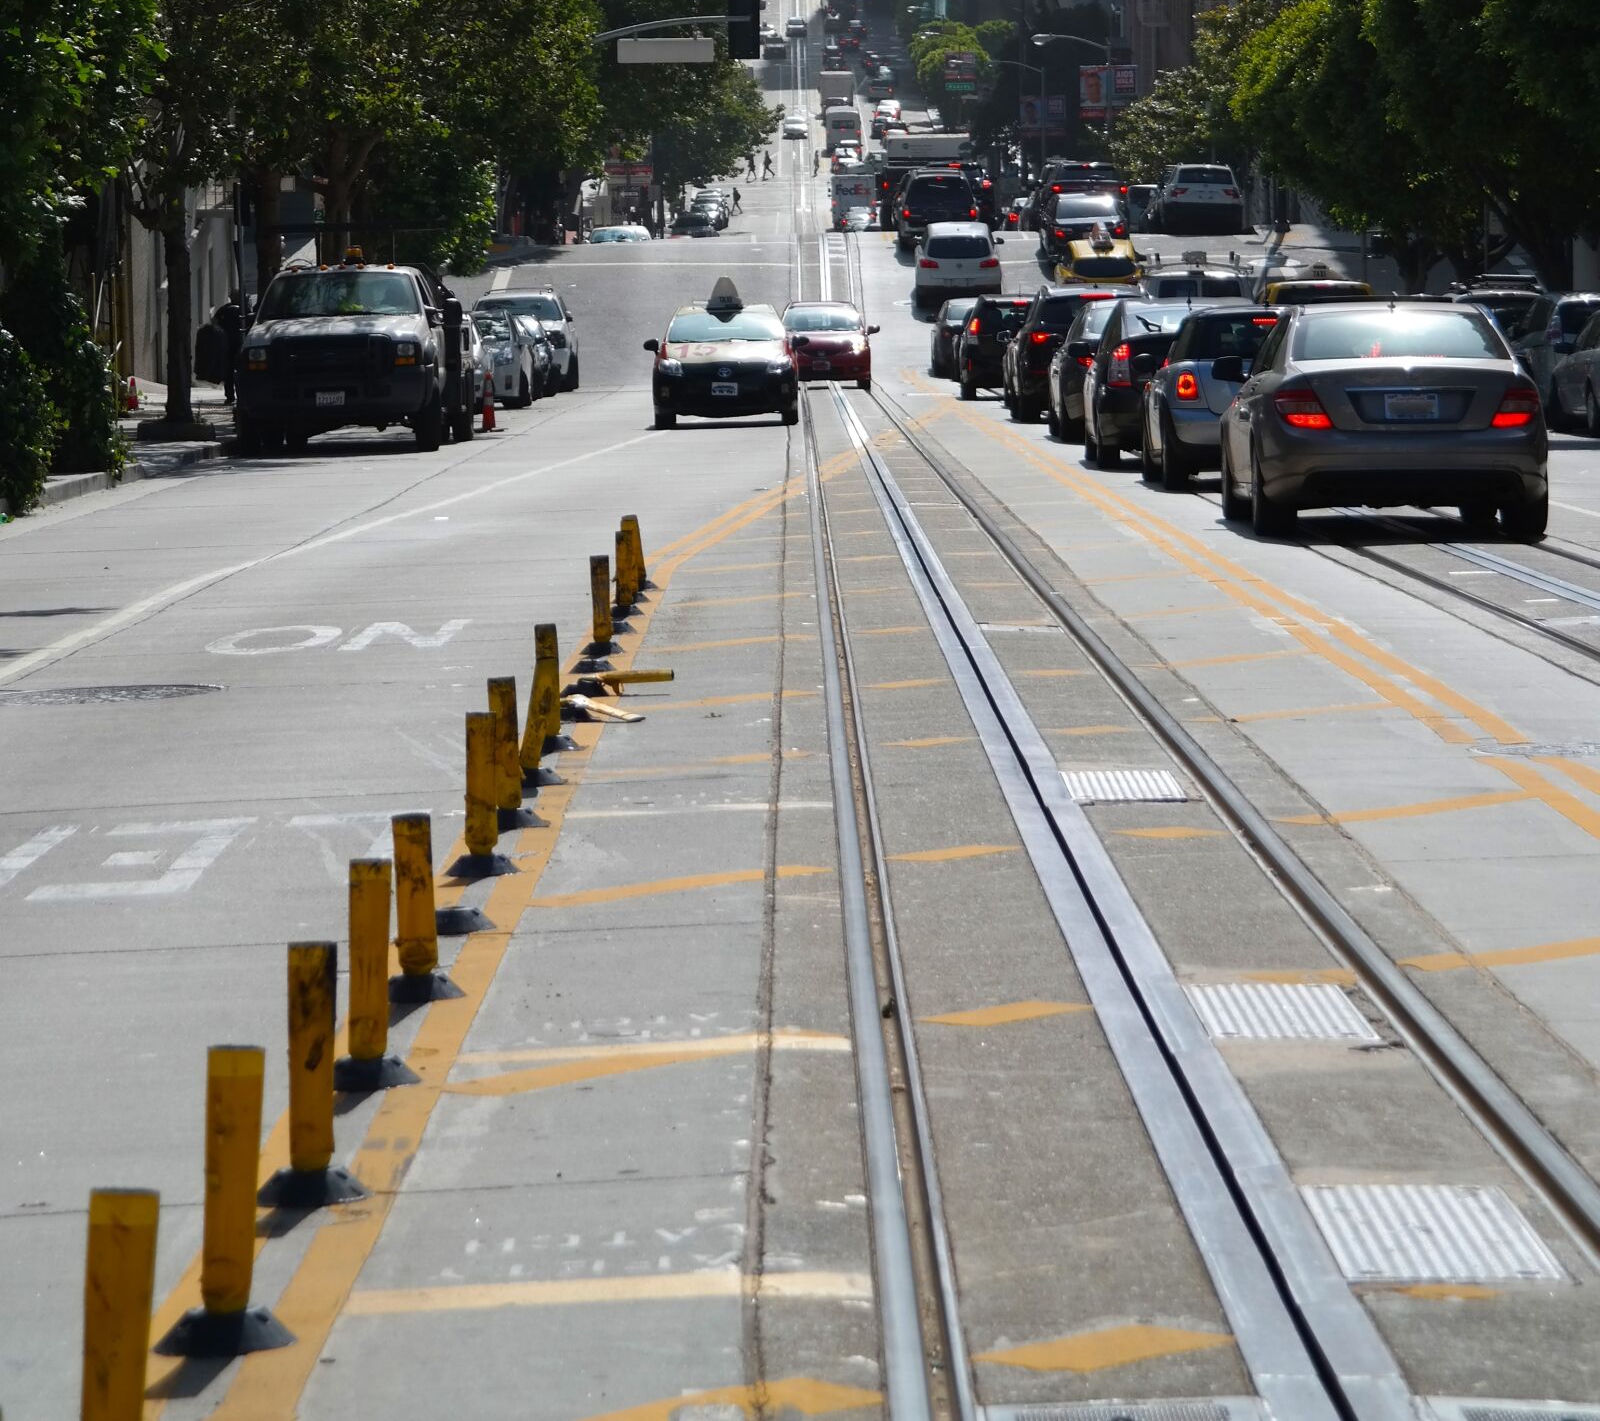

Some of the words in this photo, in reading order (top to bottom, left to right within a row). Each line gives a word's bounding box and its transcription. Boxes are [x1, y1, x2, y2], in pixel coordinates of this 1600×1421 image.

[1116, 70, 1134, 78] AIDS
[835, 184, 871, 196] FedEx
[673, 344, 717, 359] 15
[204, 618, 473, 655] NO
